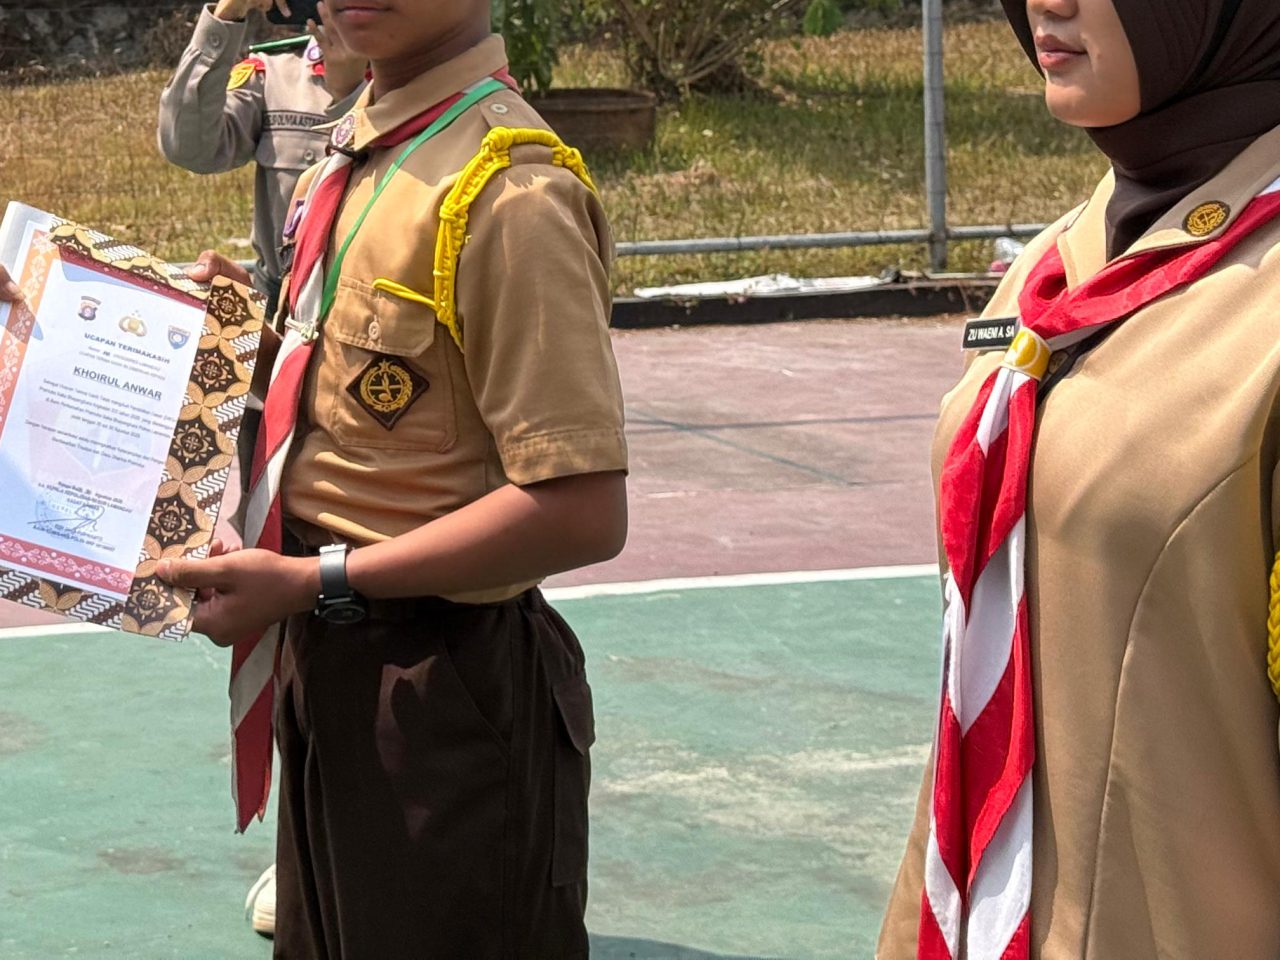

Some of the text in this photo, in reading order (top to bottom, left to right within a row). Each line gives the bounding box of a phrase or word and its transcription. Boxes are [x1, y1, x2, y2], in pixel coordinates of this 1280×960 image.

[83, 332, 116, 347] UCAPAN
[117, 342, 171, 364] TERIMAKASIH
[73, 365, 121, 388] KHOIRUL
[122, 381, 162, 401] ANWAR
